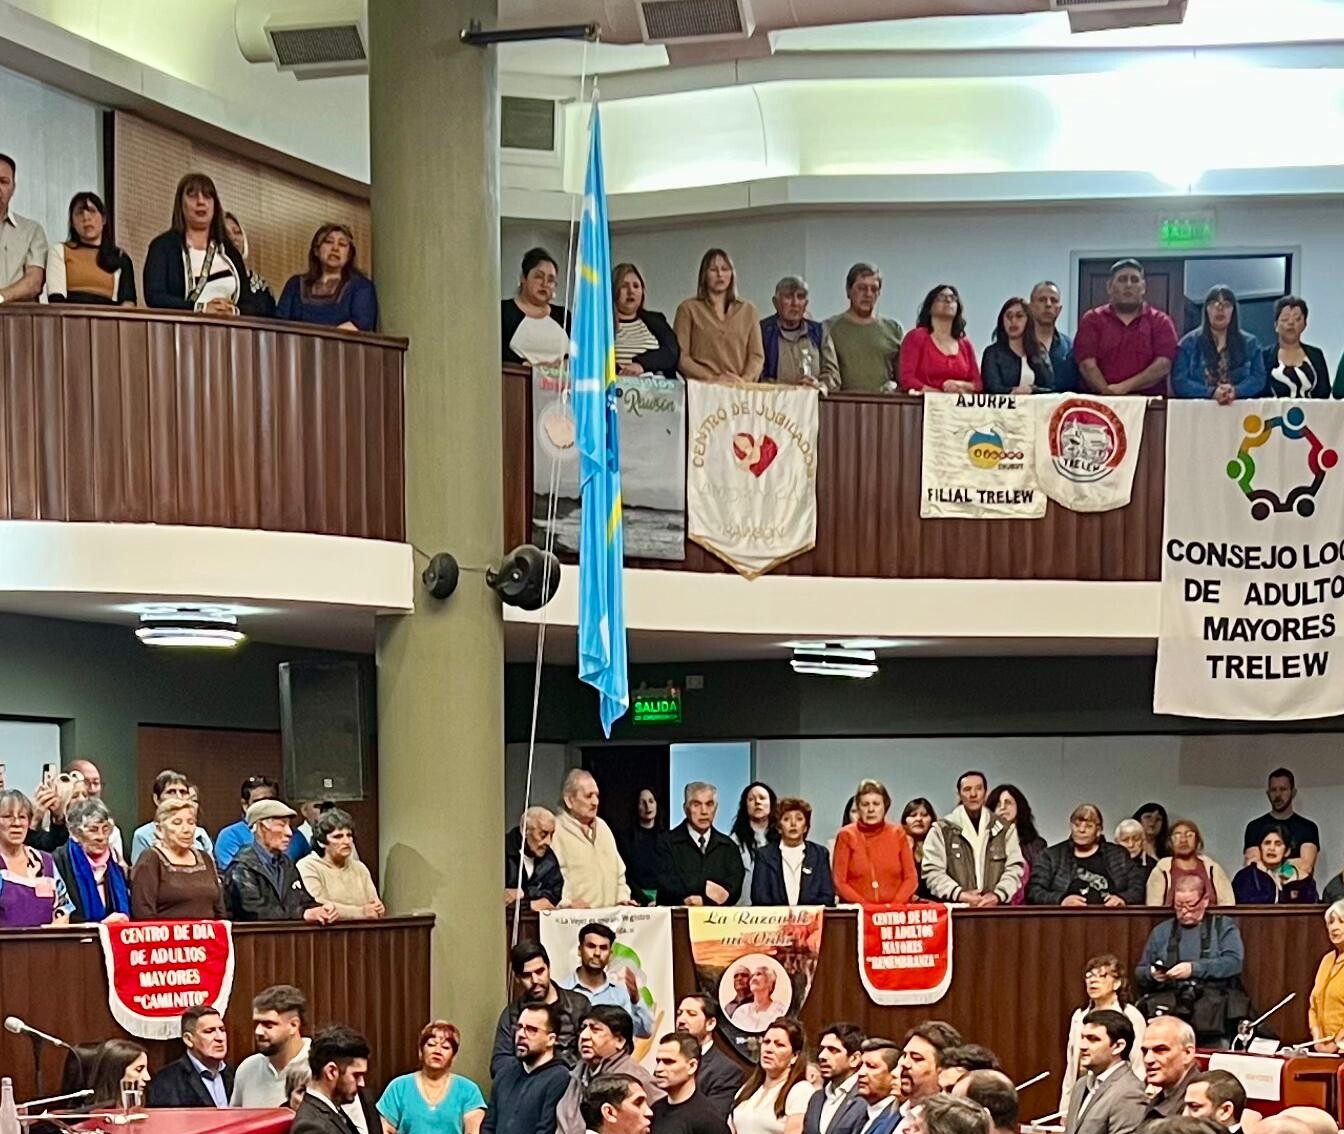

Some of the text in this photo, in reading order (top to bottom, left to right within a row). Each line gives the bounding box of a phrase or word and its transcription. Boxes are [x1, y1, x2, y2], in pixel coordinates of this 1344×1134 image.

[693, 408, 727, 468] CENTRO
[732, 401, 751, 416] DE
[927, 487, 1034, 504] FILIAL TRELEW
[1166, 538, 1297, 569] CONSEJO
[1184, 578, 1221, 603] DE
[1203, 613, 1336, 642] MAYORES
[1206, 651, 1329, 680] TRELEW
[635, 701, 677, 713] SALIDA
[704, 911, 727, 925] La
[872, 909, 938, 926] CENTRO DE DIA
[120, 923, 215, 944] CENTRO DE DIA
[880, 924, 934, 940] DE ADULTOS
[130, 946, 206, 966] DE ADULTOS
[881, 940, 923, 954] MAYORES
[139, 968, 200, 988] MAYORES
[134, 990, 209, 1010] "CAMINITO"
